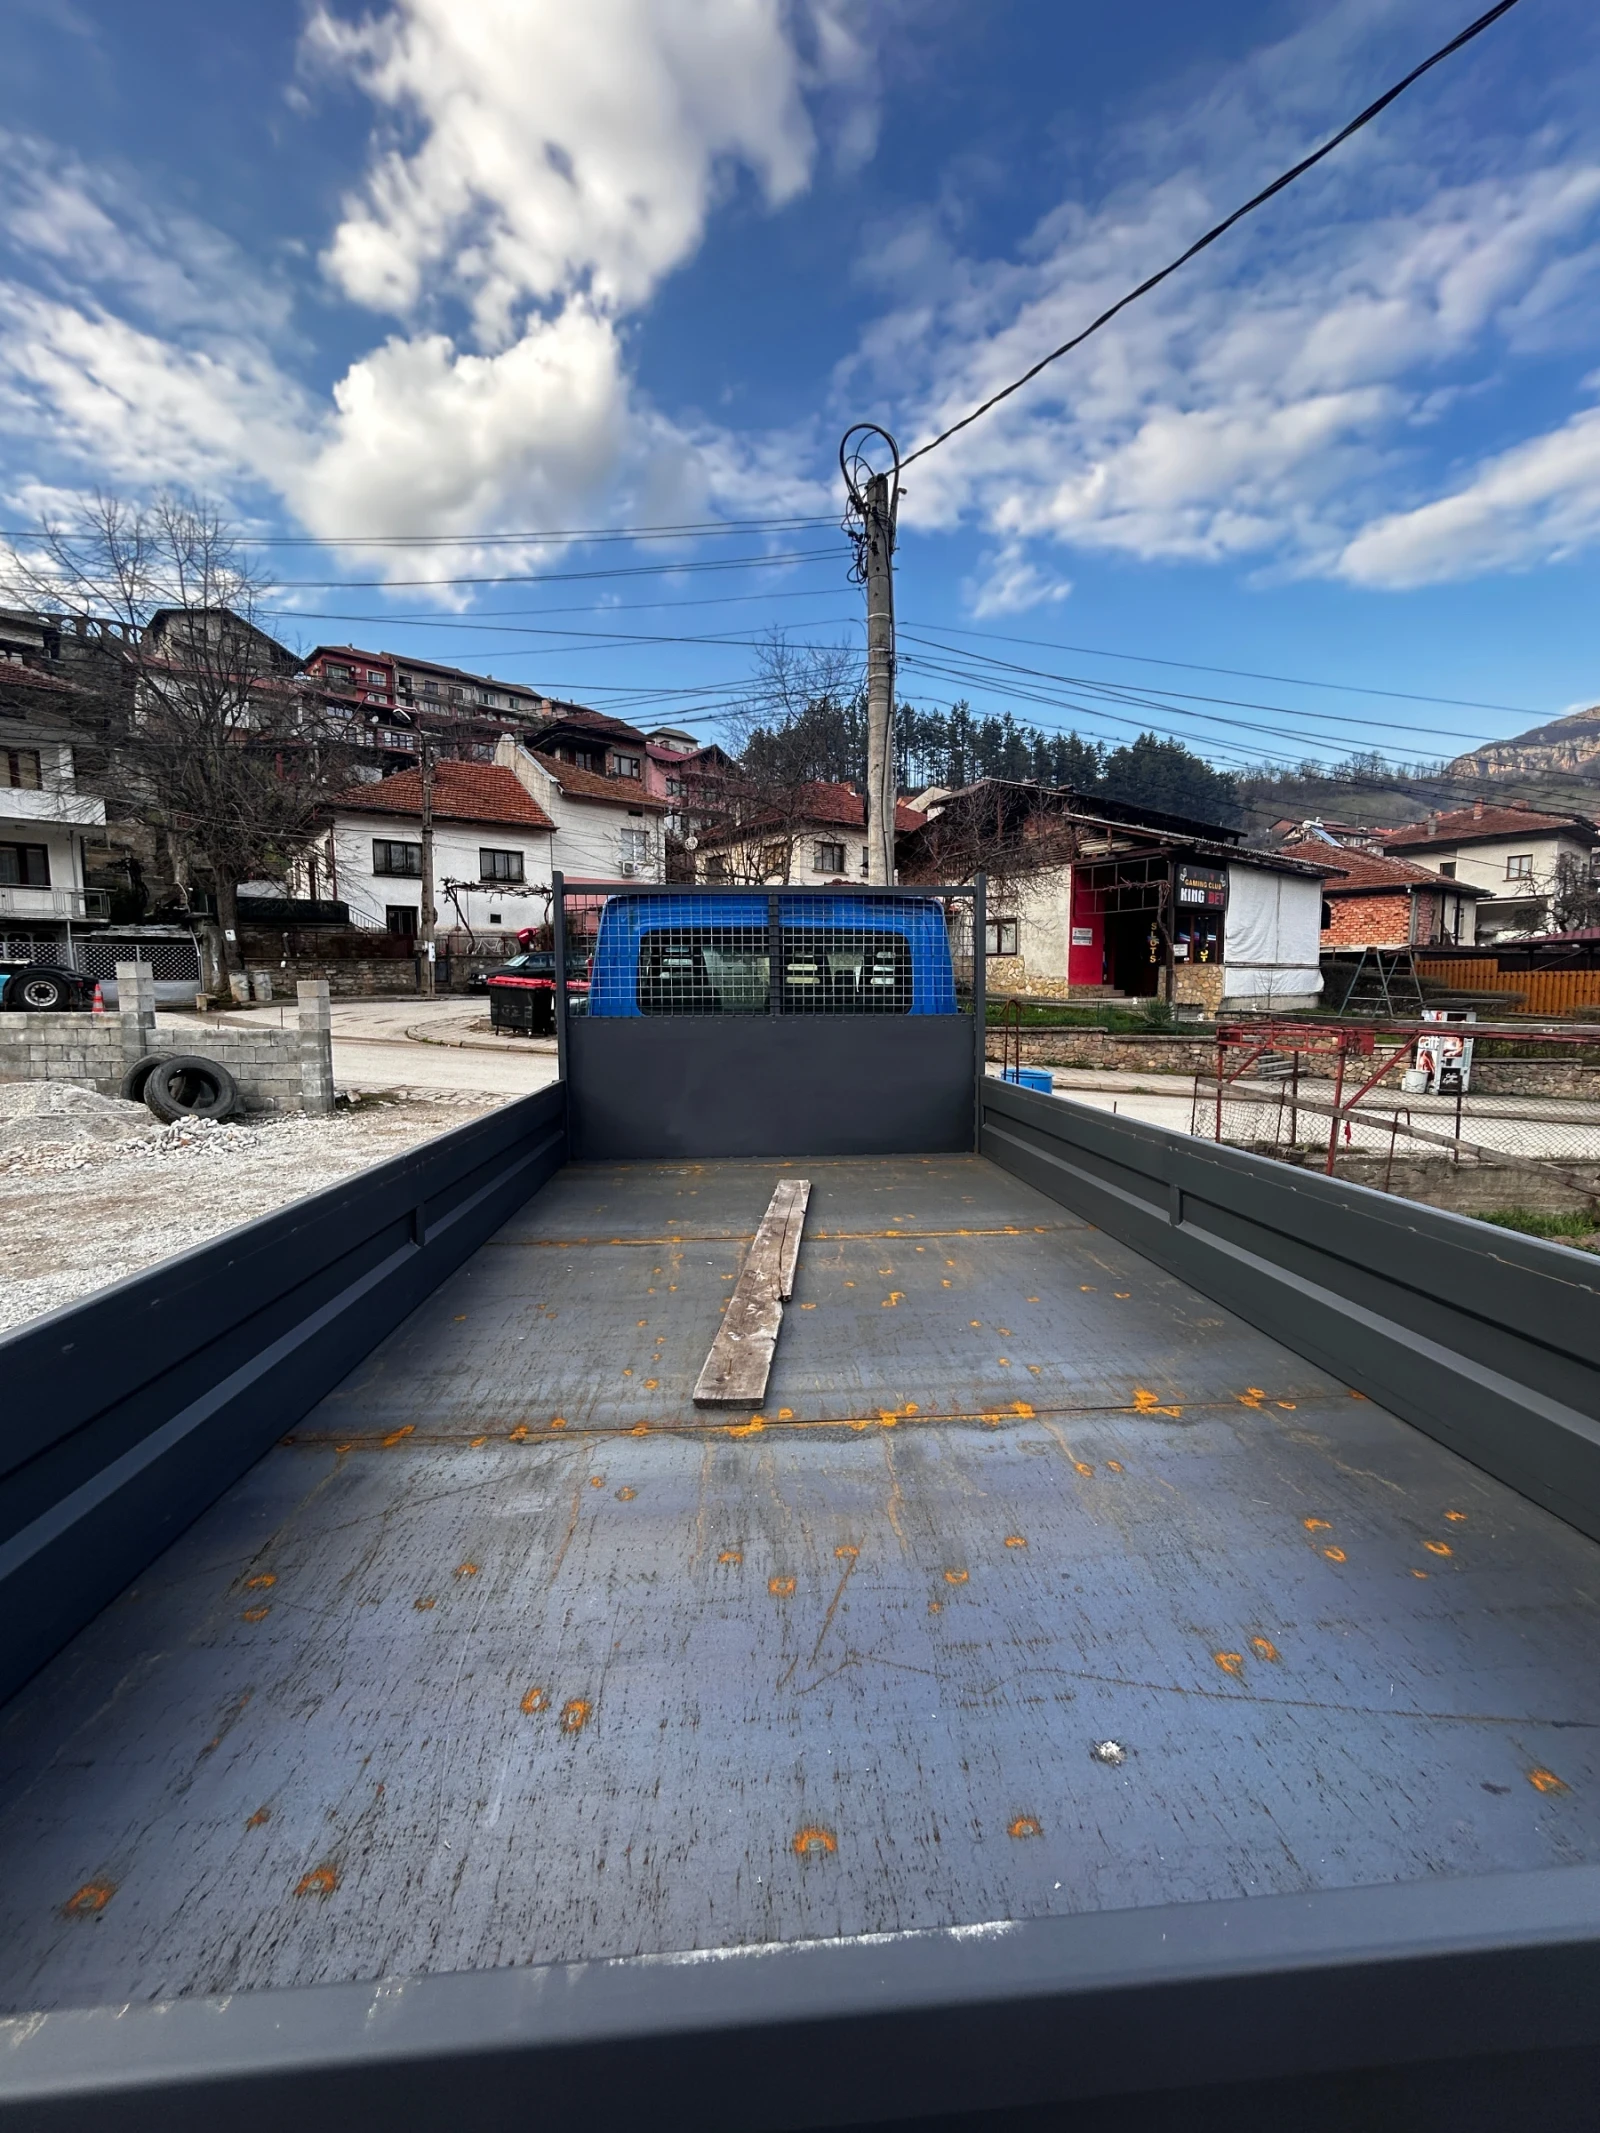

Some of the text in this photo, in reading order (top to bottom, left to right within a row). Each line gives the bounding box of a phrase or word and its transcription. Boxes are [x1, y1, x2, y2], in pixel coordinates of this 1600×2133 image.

[1185, 879, 1222, 890] GAMING CLUB
[1180, 887, 1225, 905] KING BET
